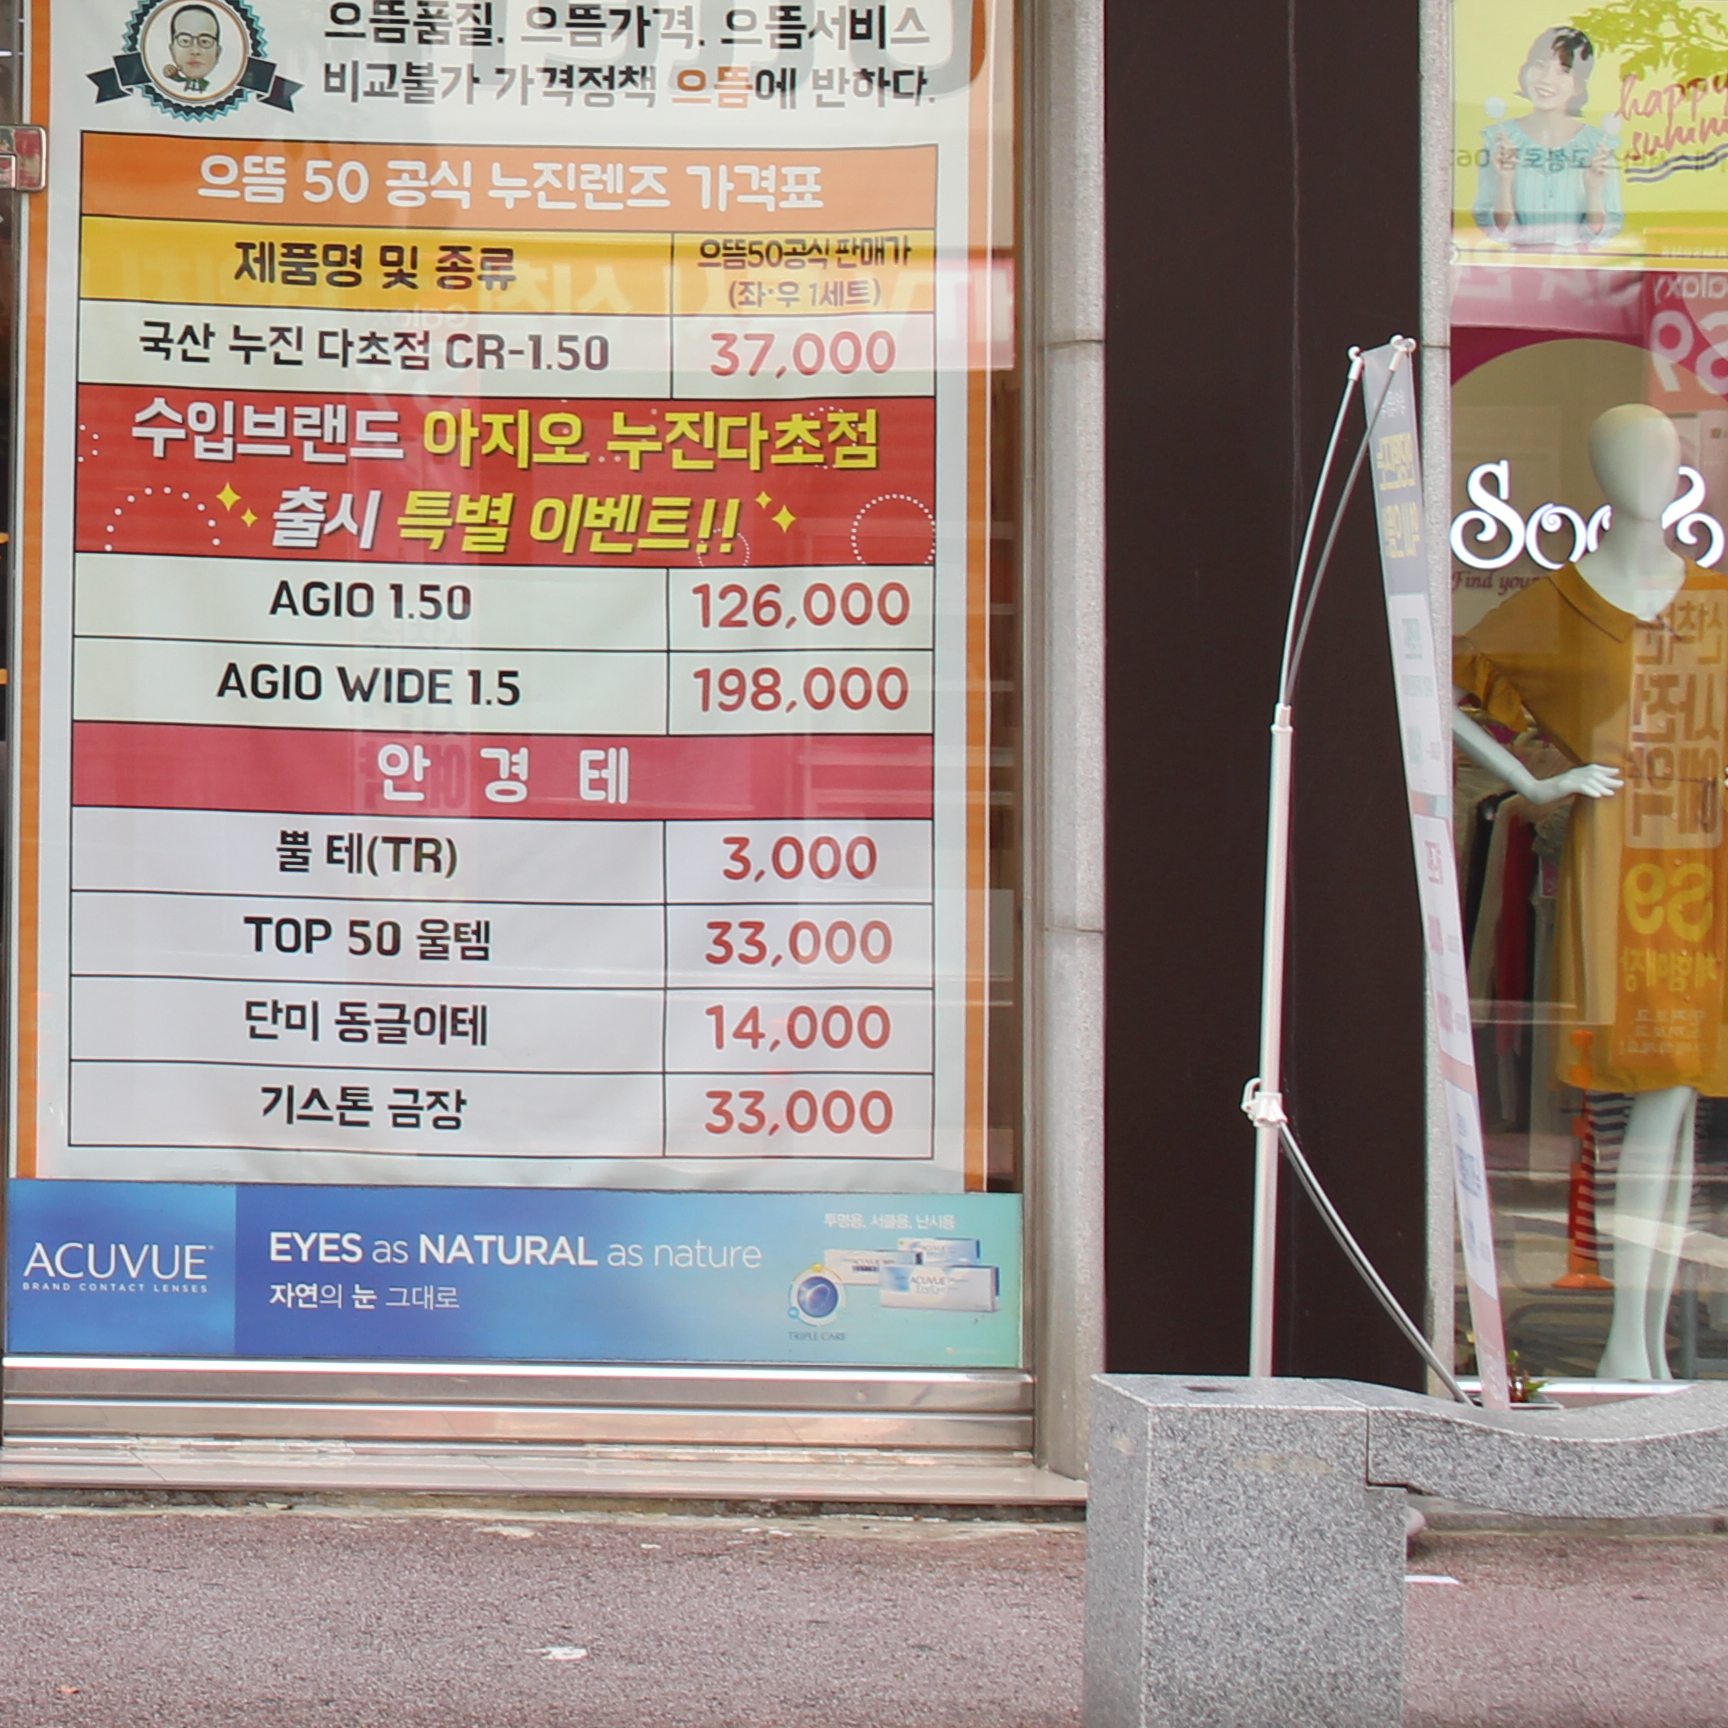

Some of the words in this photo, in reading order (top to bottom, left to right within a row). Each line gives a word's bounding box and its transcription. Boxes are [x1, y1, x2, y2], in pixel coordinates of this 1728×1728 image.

[323, 0, 505, 46] 으뜸품질.
[520, 4, 706, 49] 으뜸가격.
[720, 4, 932, 51] 으뜸서비스
[234, 240, 364, 288] 제품명
[379, 245, 419, 290] 및
[435, 244, 518, 292] 종류
[137, 320, 215, 364] 국산
[227, 323, 304, 368] 누진
[317, 327, 432, 370] 다초점
[444, 332, 610, 372] CR-1.50
[709, 330, 897, 379] 37,000
[130, 396, 404, 464] 수입브랜드
[422, 407, 589, 470] 아지오
[606, 407, 880, 471] 누진다초점
[271, 485, 382, 551] 출시
[396, 489, 515, 554] 특별
[528, 492, 741, 555] 이벤트!!
[268, 580, 375, 618] AGIO
[388, 583, 473, 621] 1.50
[690, 581, 911, 630] 126,000
[275, 829, 313, 873] 뿔
[325, 832, 459, 878] 테(TR)
[721, 835, 878, 883] 3,000
[243, 916, 332, 955] TOP
[347, 919, 401, 957] 50
[415, 918, 492, 962] 울템
[704, 919, 893, 968] 33,000
[259, 1084, 375, 1128] 기스톤
[386, 1087, 469, 1131] 금장
[704, 1089, 894, 1136] 33,000
[22, 1241, 209, 1280] ACUVUE
[269, 1231, 363, 1265] EYES
[371, 1239, 410, 1265] as
[418, 1233, 599, 1268] NATURAL
[607, 1240, 644, 1268] as
[653, 1238, 763, 1269] nature
[22, 1281, 71, 1292] BRAND
[79, 1282, 146, 1293] CONTACT
[152, 1283, 208, 1294] LENSES
[269, 1283, 343, 1310] 자연의
[350, 1283, 377, 1310] 눈
[385, 1284, 460, 1311] 그대로
[788, 1330, 819, 1341] TRIPLE
